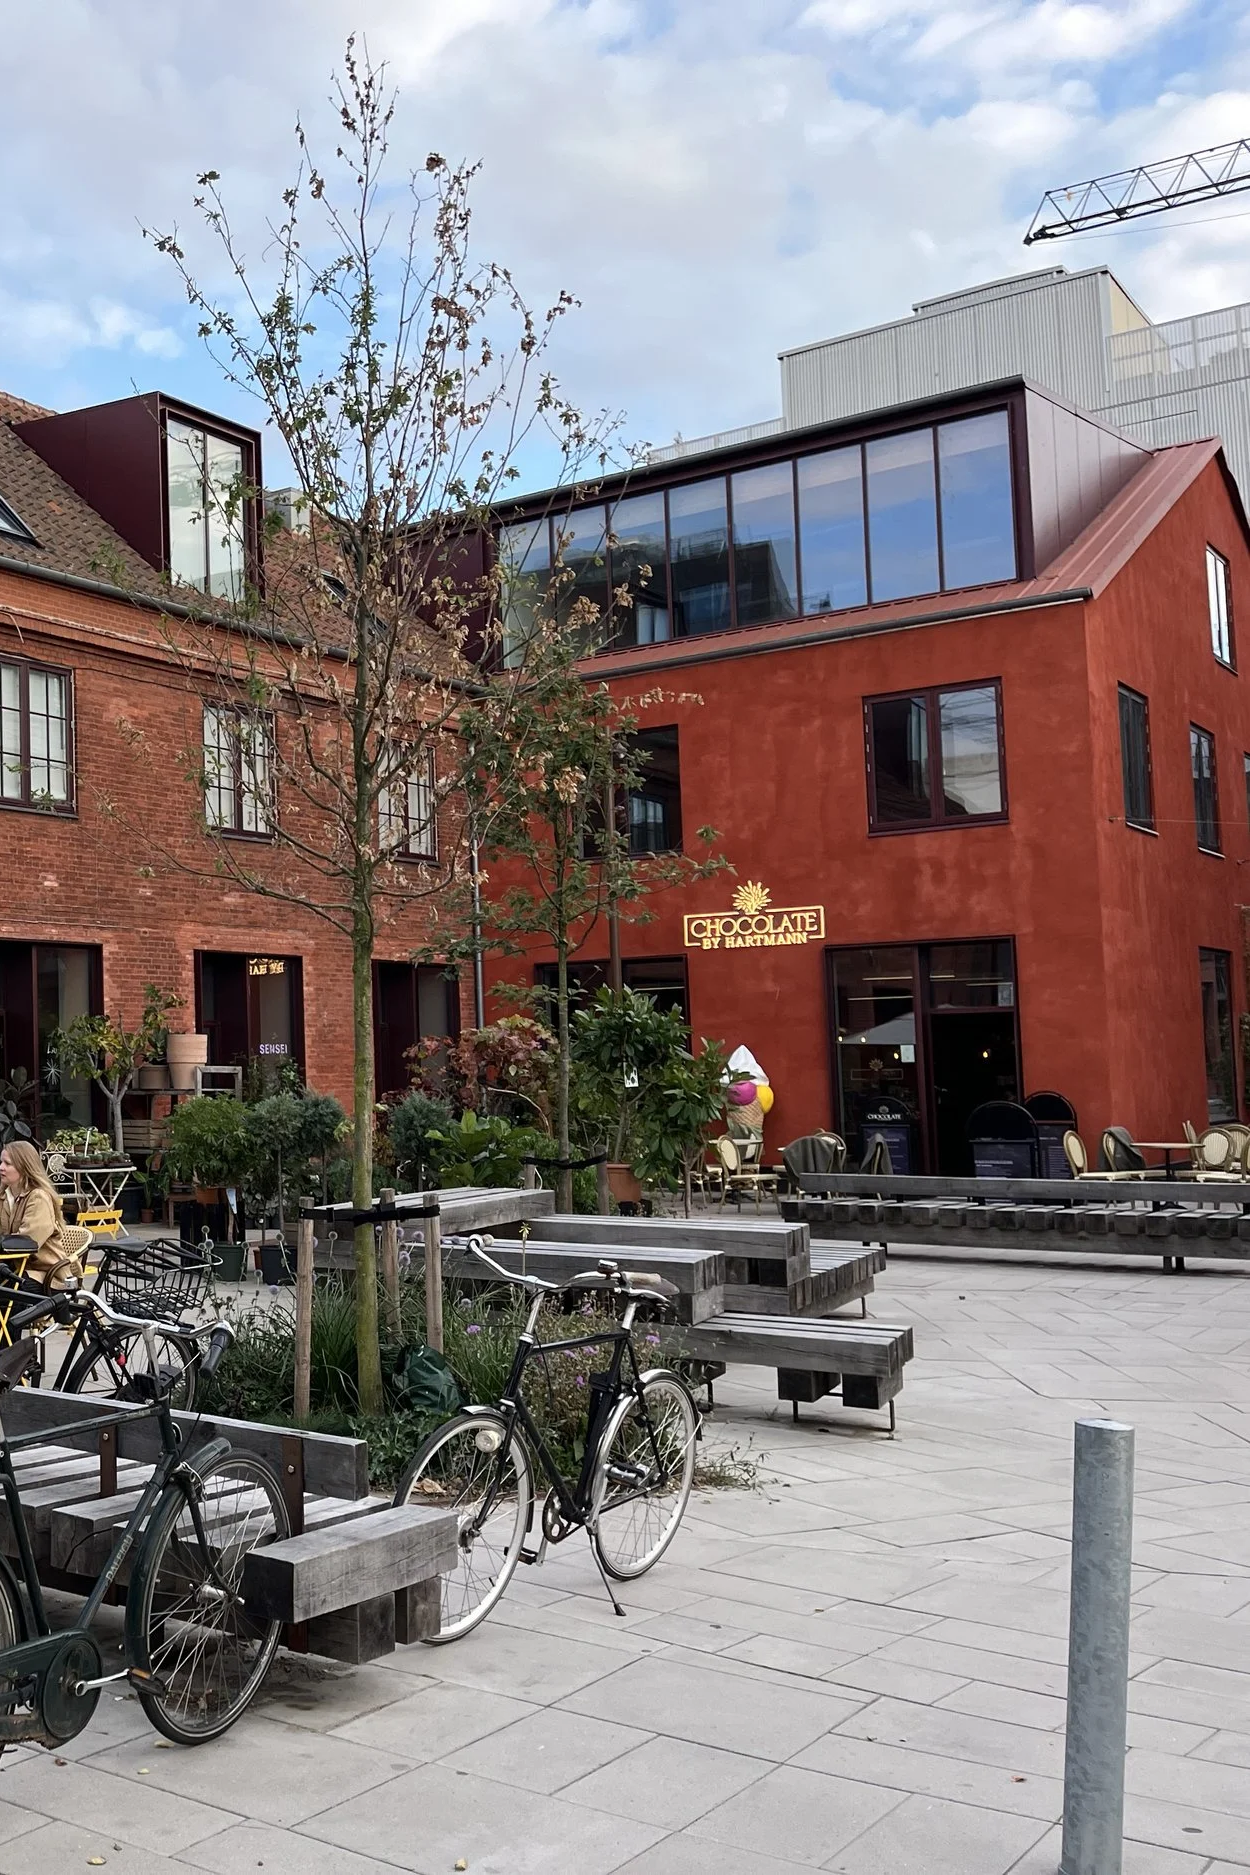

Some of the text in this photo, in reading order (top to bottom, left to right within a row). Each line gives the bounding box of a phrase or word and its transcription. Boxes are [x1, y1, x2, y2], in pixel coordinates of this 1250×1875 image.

[690, 912, 818, 938] CHOCOLATE
[702, 932, 808, 950] BY HARTMANN
[259, 1043, 288, 1055] SENSEI
